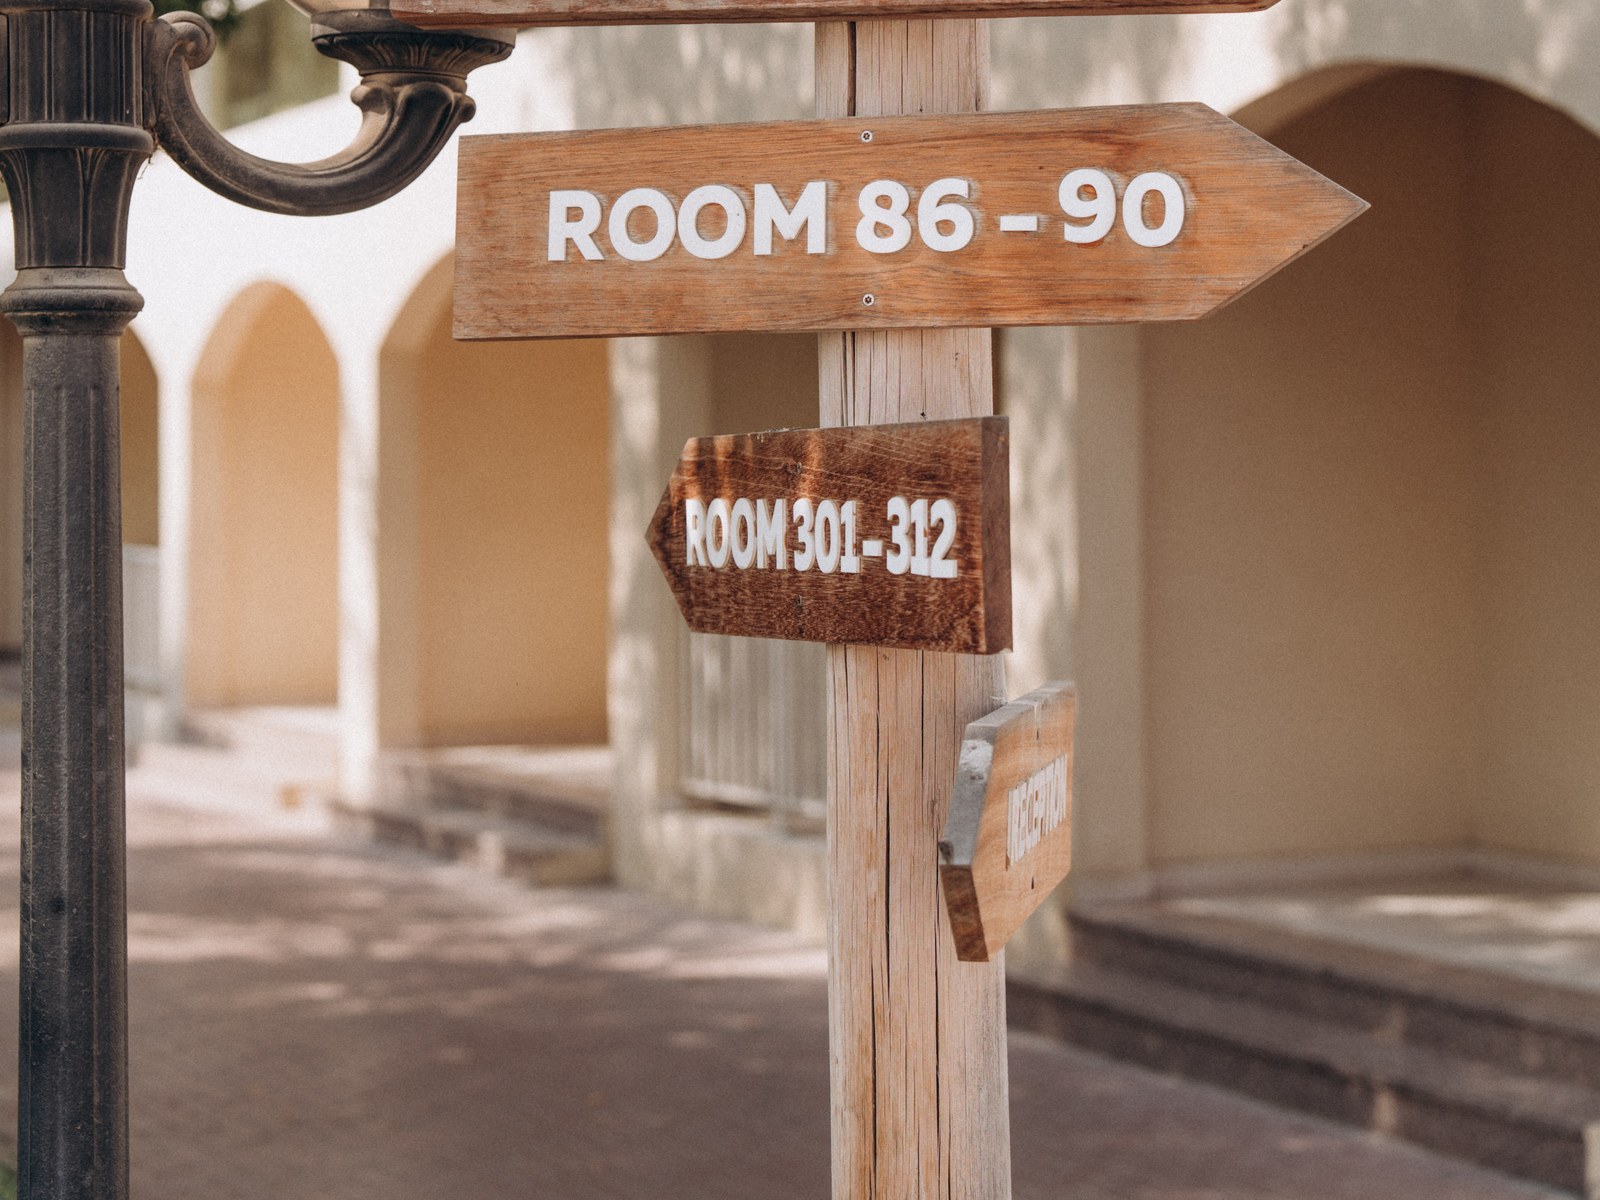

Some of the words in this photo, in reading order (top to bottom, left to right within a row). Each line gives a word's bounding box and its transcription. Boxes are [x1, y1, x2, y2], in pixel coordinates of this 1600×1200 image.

[547, 181, 828, 261] ROOM
[856, 178, 976, 253] 86
[1058, 168, 1186, 247] 90
[685, 497, 788, 569] ROOM
